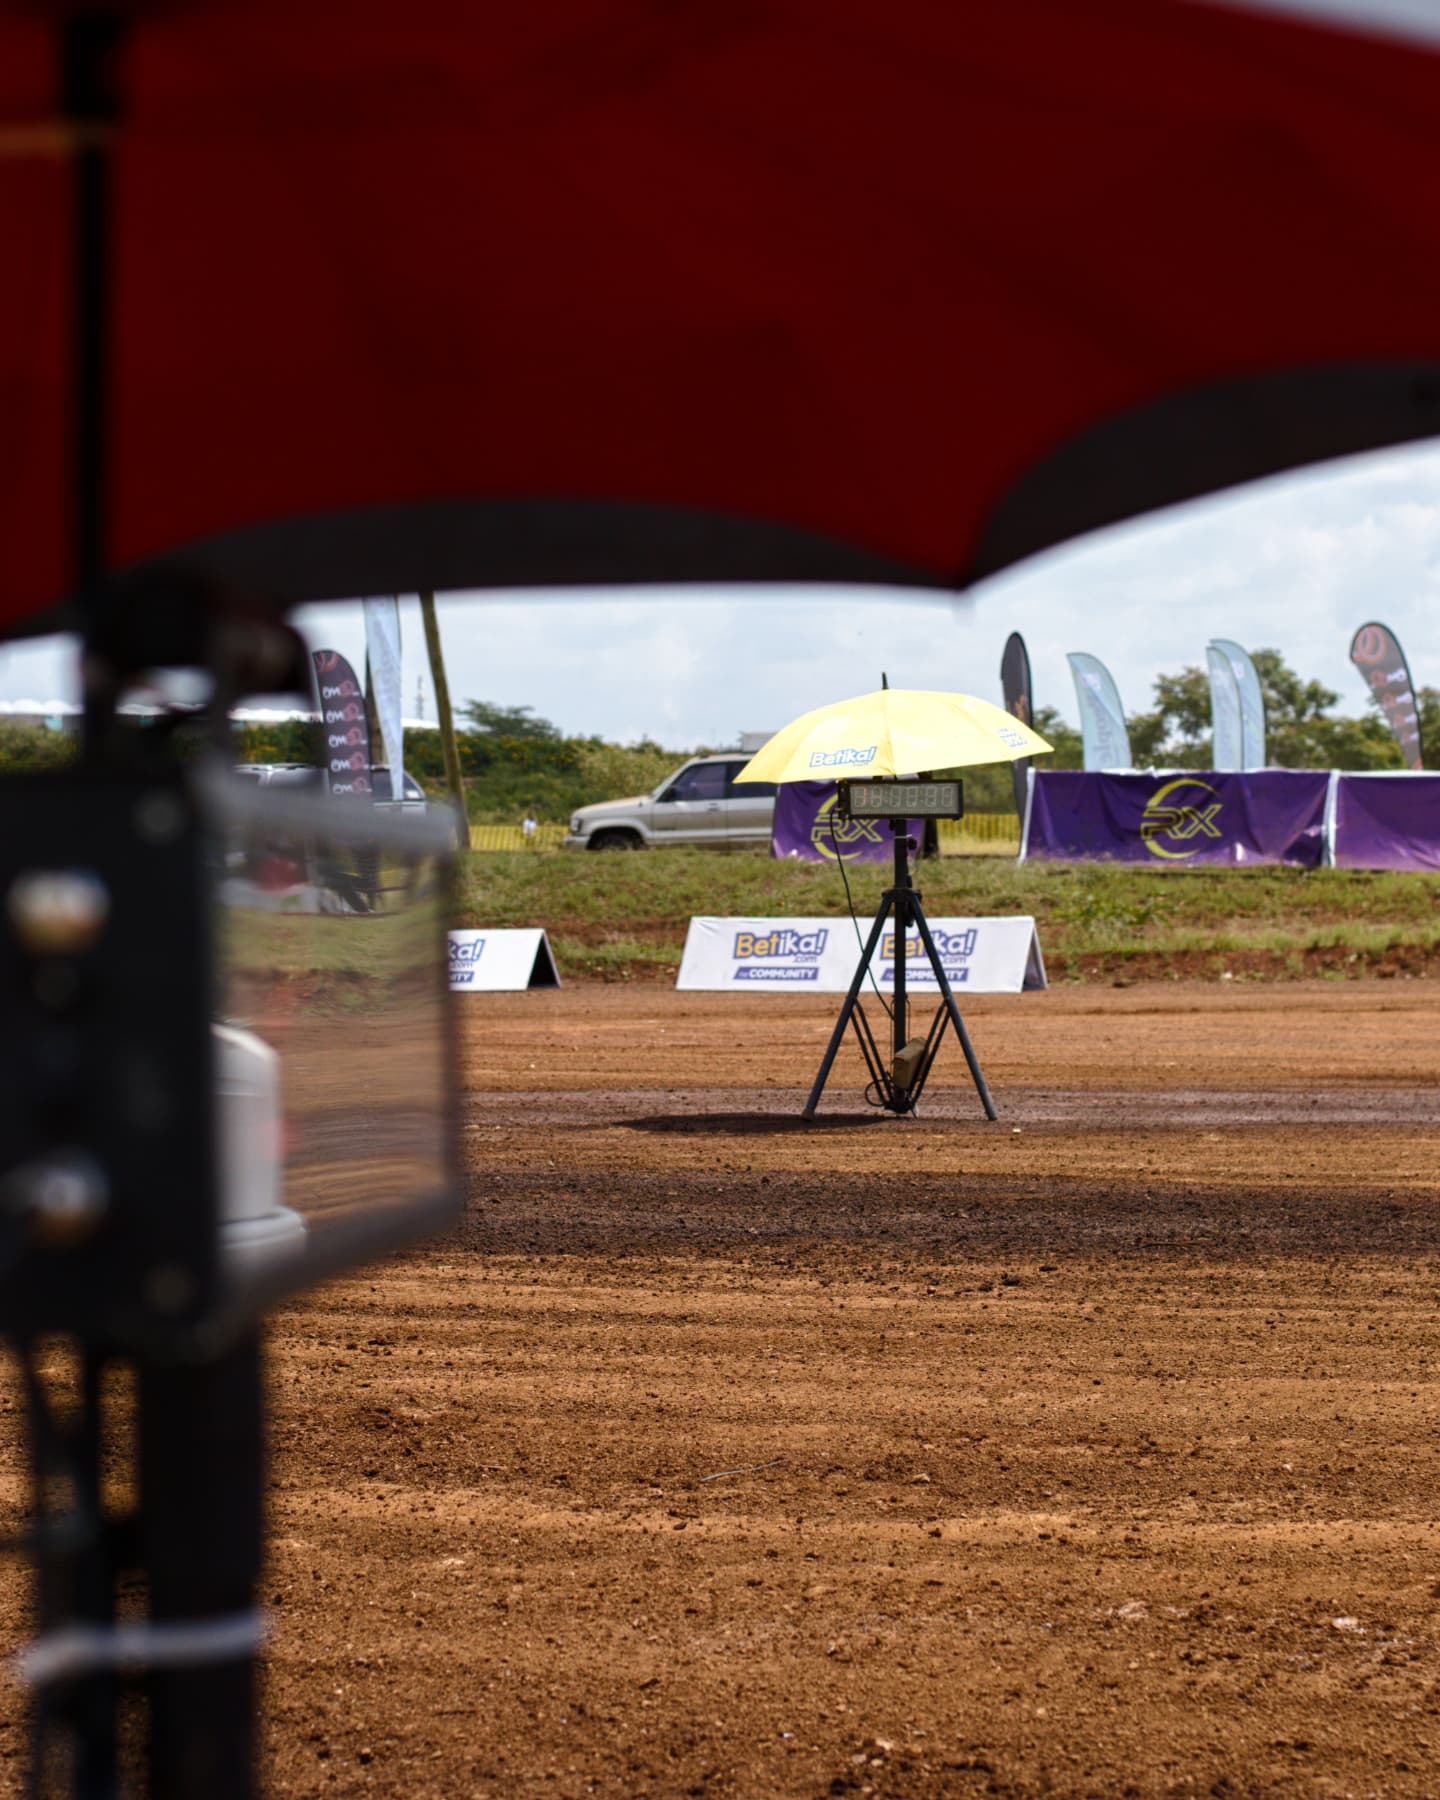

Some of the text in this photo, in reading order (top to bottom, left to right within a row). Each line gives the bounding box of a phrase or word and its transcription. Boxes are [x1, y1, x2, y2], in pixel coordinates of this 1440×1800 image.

[809, 746, 877, 768] Betika!
[733, 928, 828, 959] Betika!
[881, 929, 977, 959] Betka!
[749, 968, 815, 979] COMMUNITY
